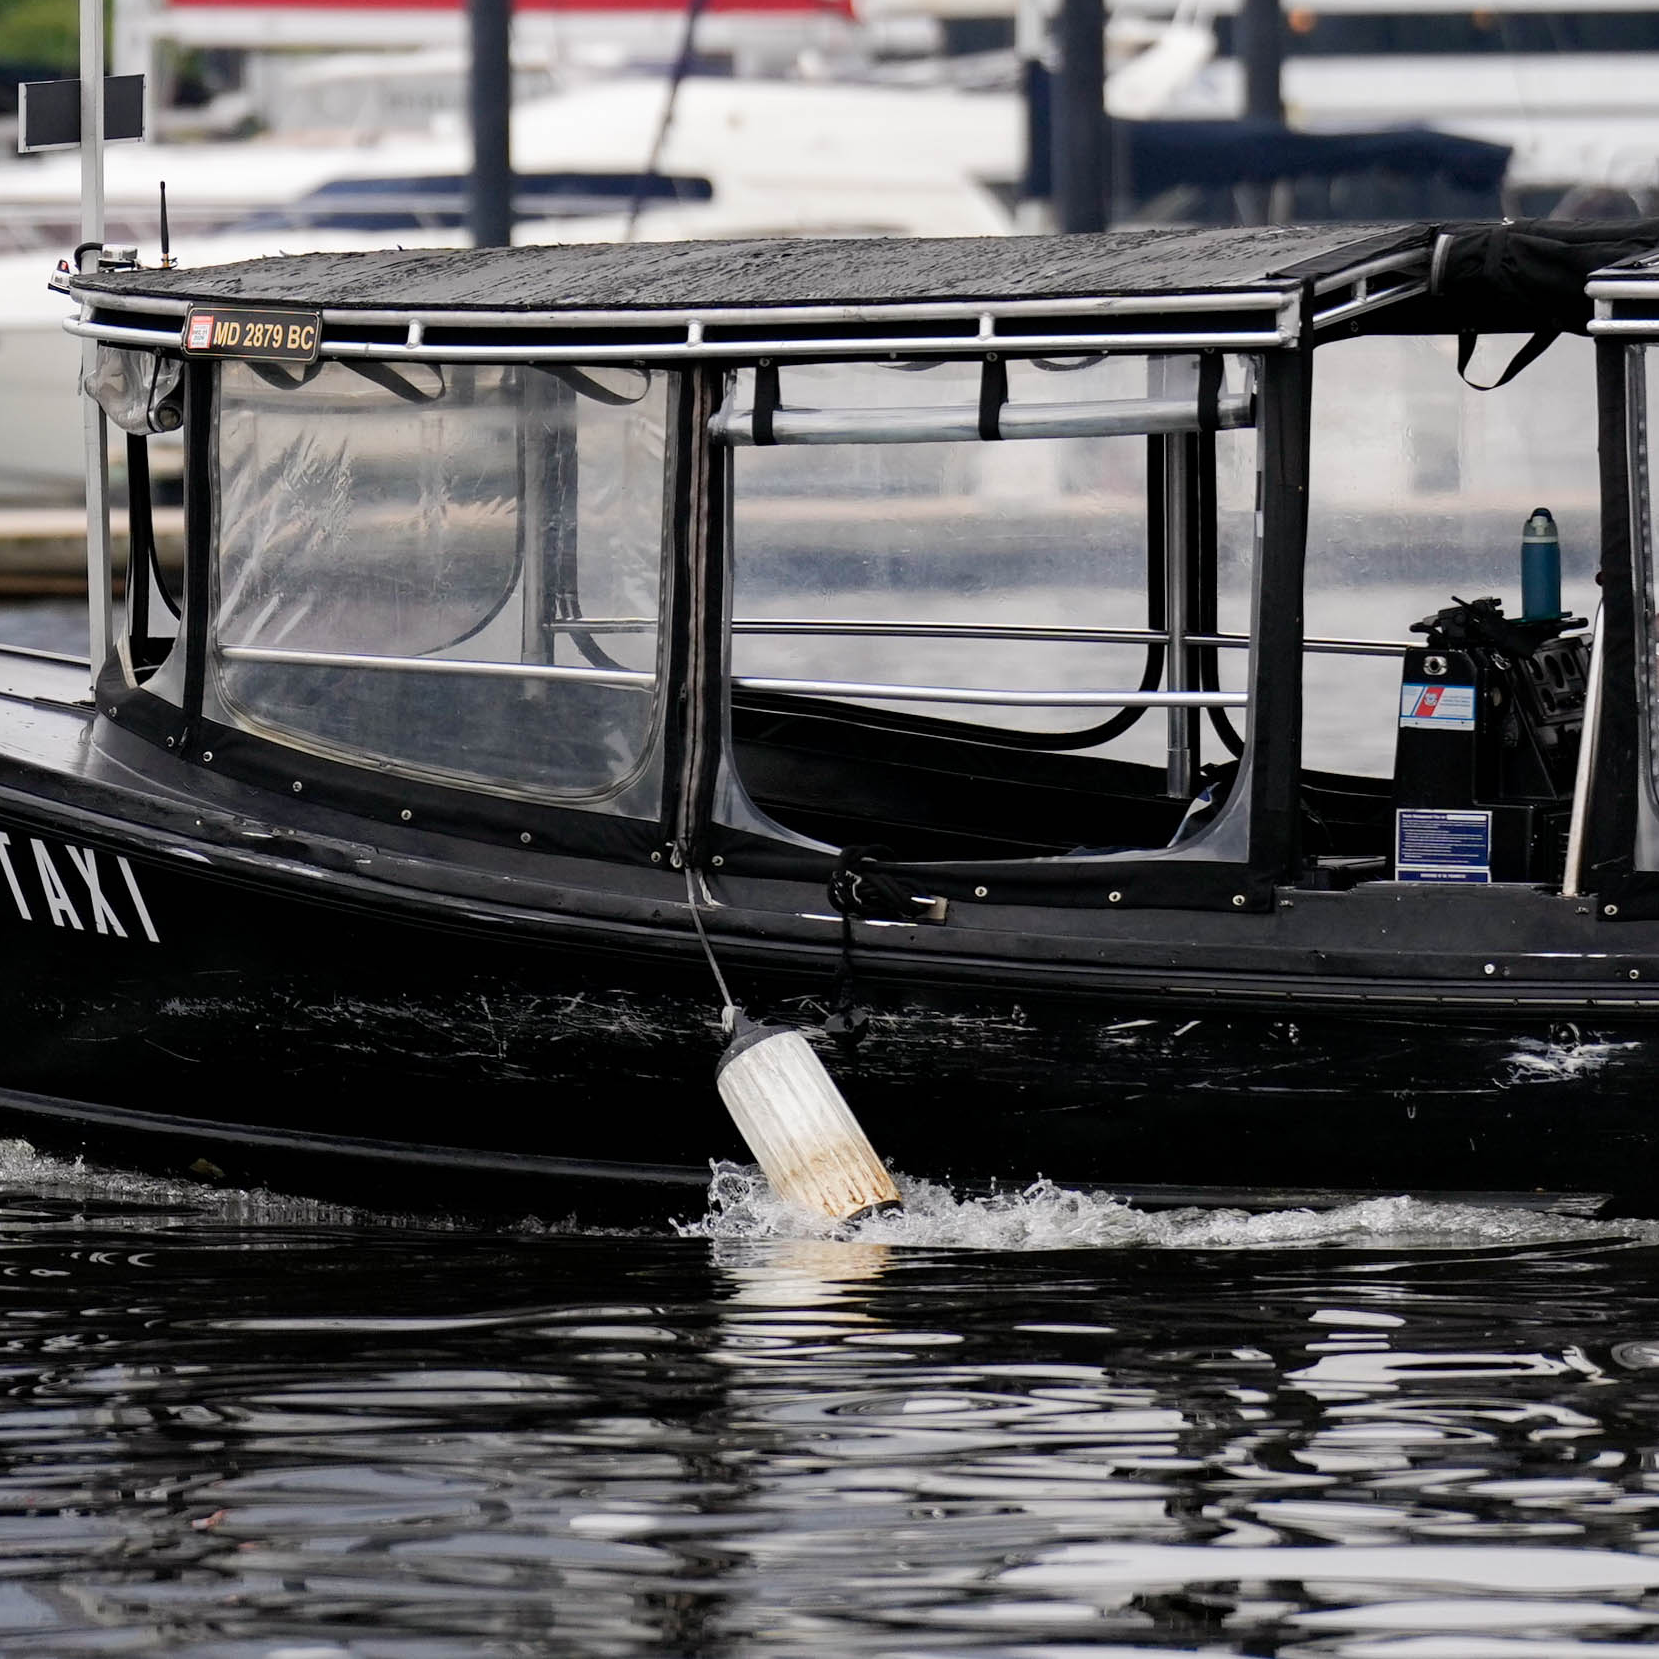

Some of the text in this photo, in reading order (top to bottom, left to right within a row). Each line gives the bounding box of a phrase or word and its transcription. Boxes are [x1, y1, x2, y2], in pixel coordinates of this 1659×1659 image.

[213, 322, 241, 346] MD
[243, 324, 282, 348] 2879
[287, 325, 314, 350] BC
